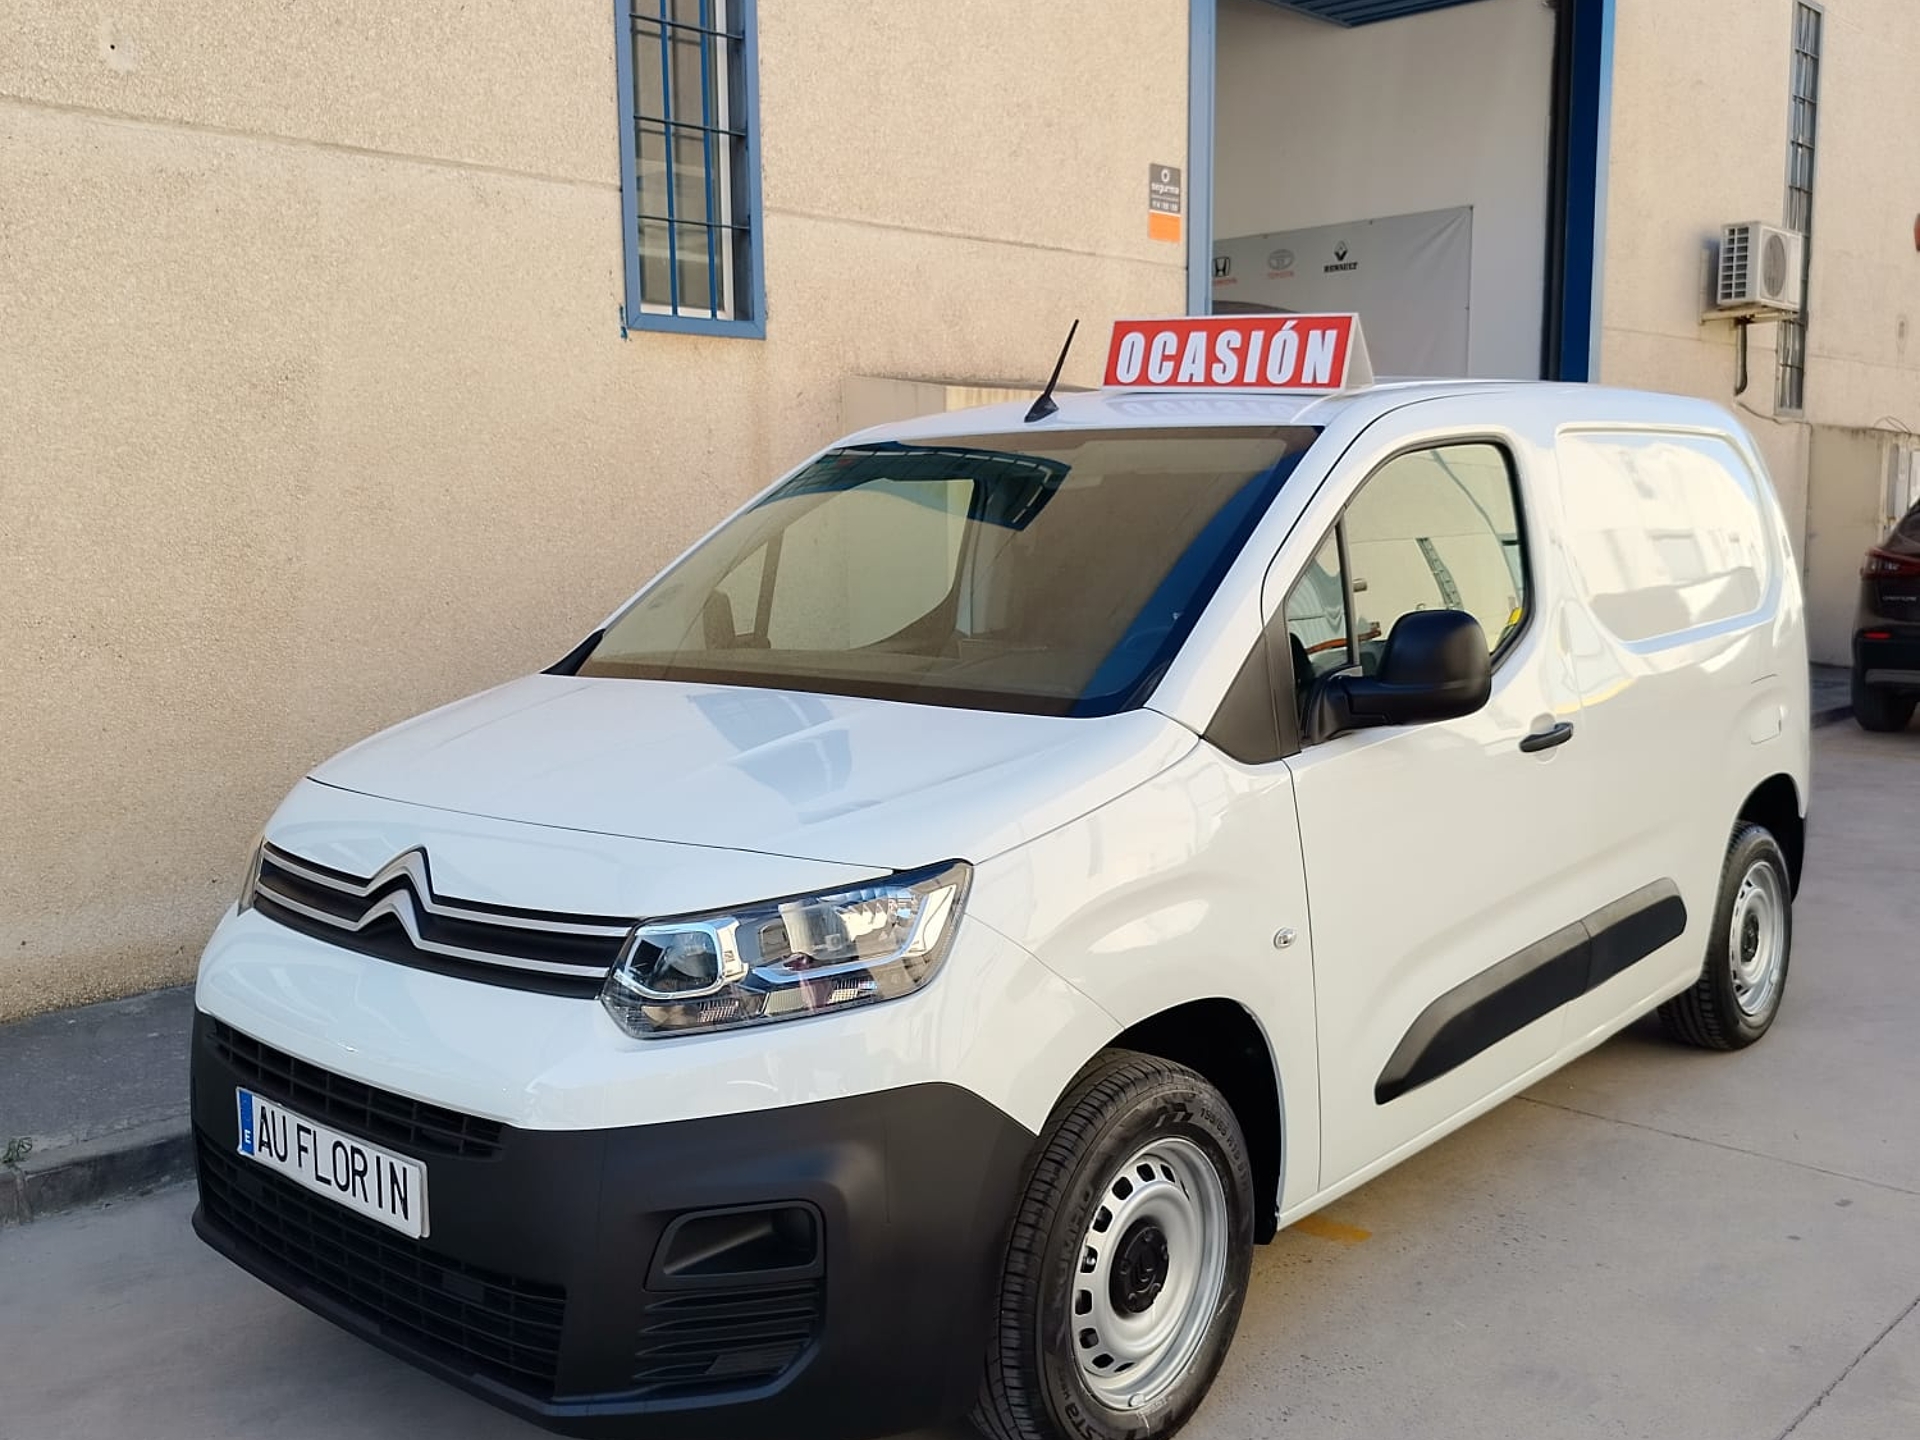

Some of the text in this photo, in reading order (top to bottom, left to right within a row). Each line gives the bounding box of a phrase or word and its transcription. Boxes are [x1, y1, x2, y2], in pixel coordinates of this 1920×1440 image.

[1115, 320, 1338, 385] OCASIÓN
[244, 1129, 252, 1144] E
[258, 1105, 410, 1221] AU FLORIN
